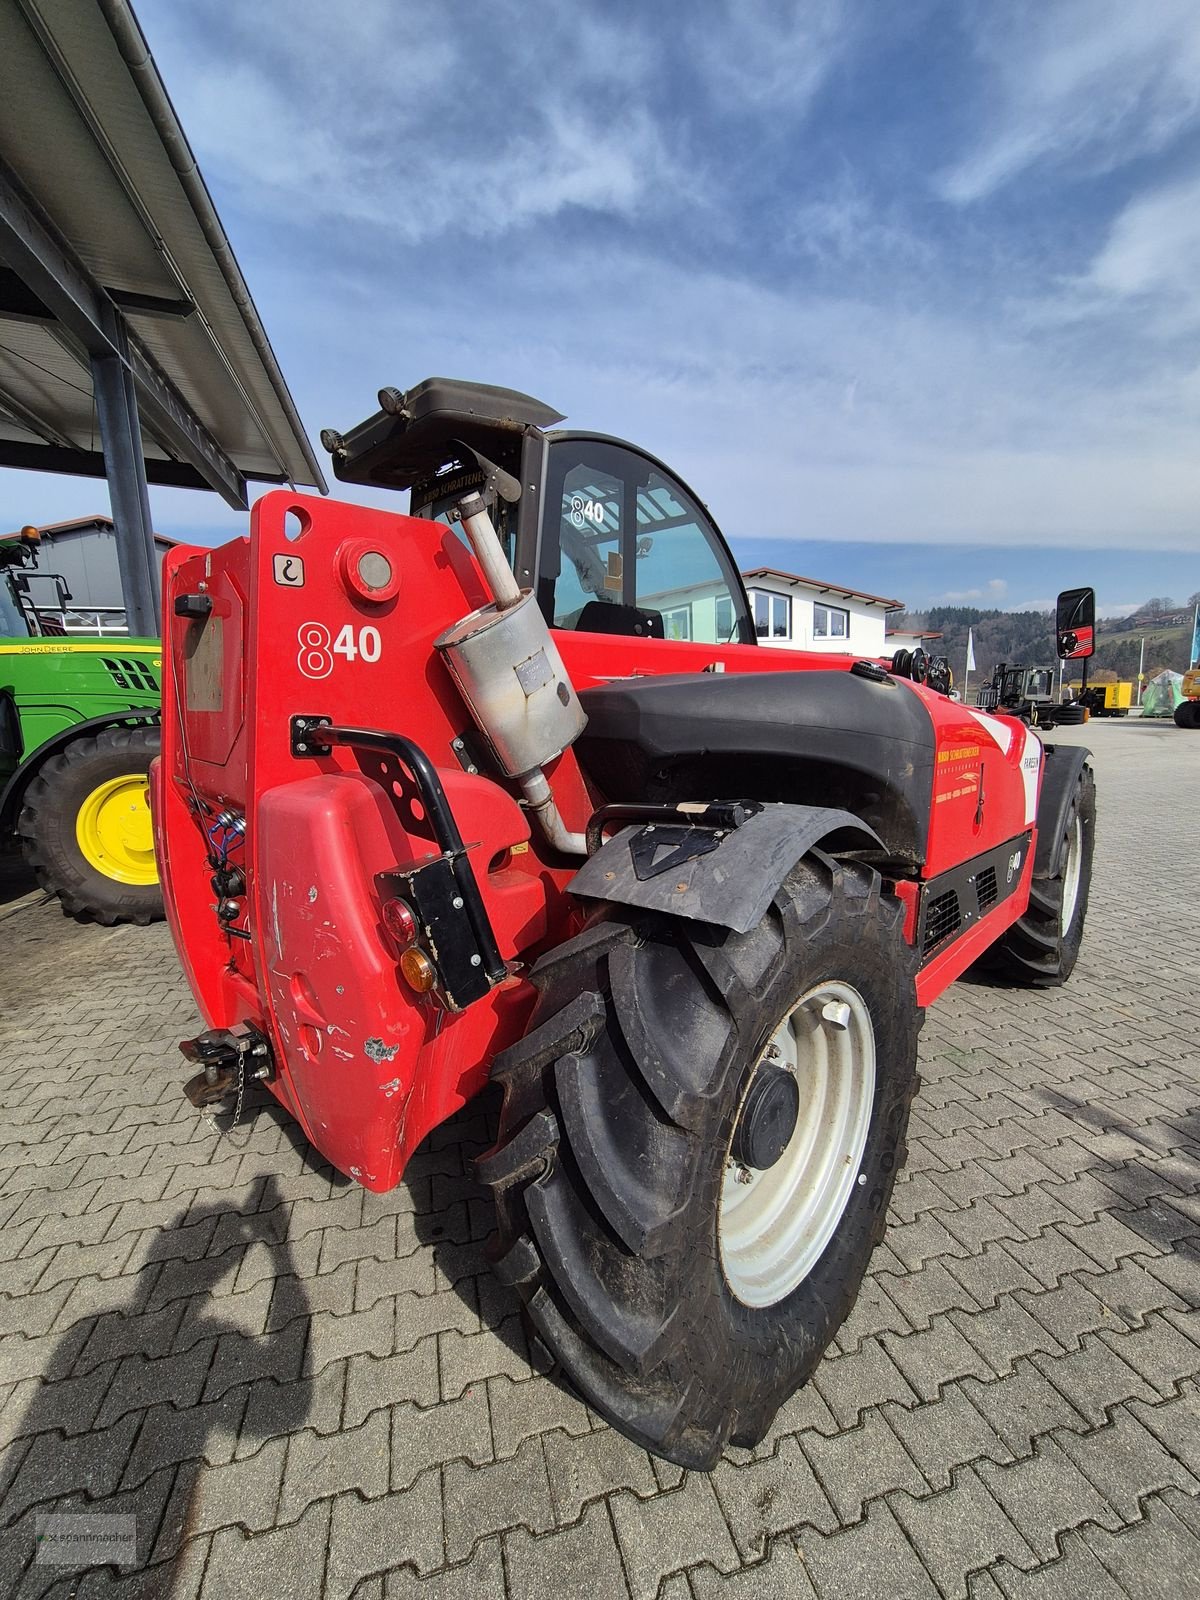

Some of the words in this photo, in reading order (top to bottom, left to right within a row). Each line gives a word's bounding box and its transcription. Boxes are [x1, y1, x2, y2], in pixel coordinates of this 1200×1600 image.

[440, 471, 488, 497] SCHRATTENEC
[571, 495, 604, 527] 840
[19, 646, 43, 654] JOHN
[44, 645, 74, 653] DEERE
[297, 621, 382, 680] 840
[1006, 850, 1021, 884] 840
